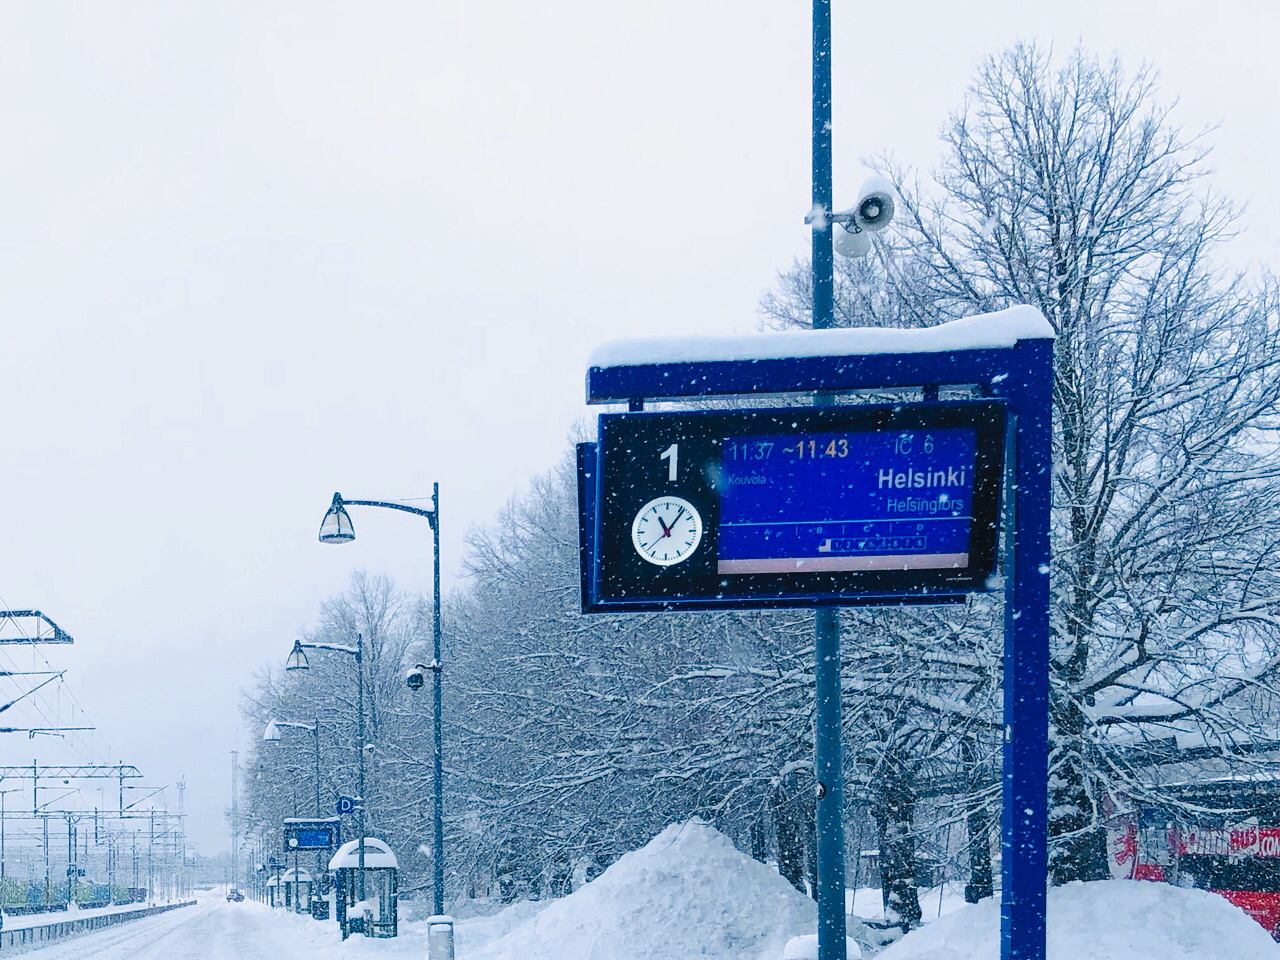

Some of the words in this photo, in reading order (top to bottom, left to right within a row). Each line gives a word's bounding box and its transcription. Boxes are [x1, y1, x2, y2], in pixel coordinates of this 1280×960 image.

[729, 442, 774, 461] 11:37
[924, 436, 934, 454] 6
[660, 443, 679, 481] 1
[728, 473, 766, 485] Kouvola
[878, 465, 965, 489] Helsinki
[887, 497, 964, 515] Helsingfors
[916, 523, 924, 531] D
[341, 799, 351, 811] D
